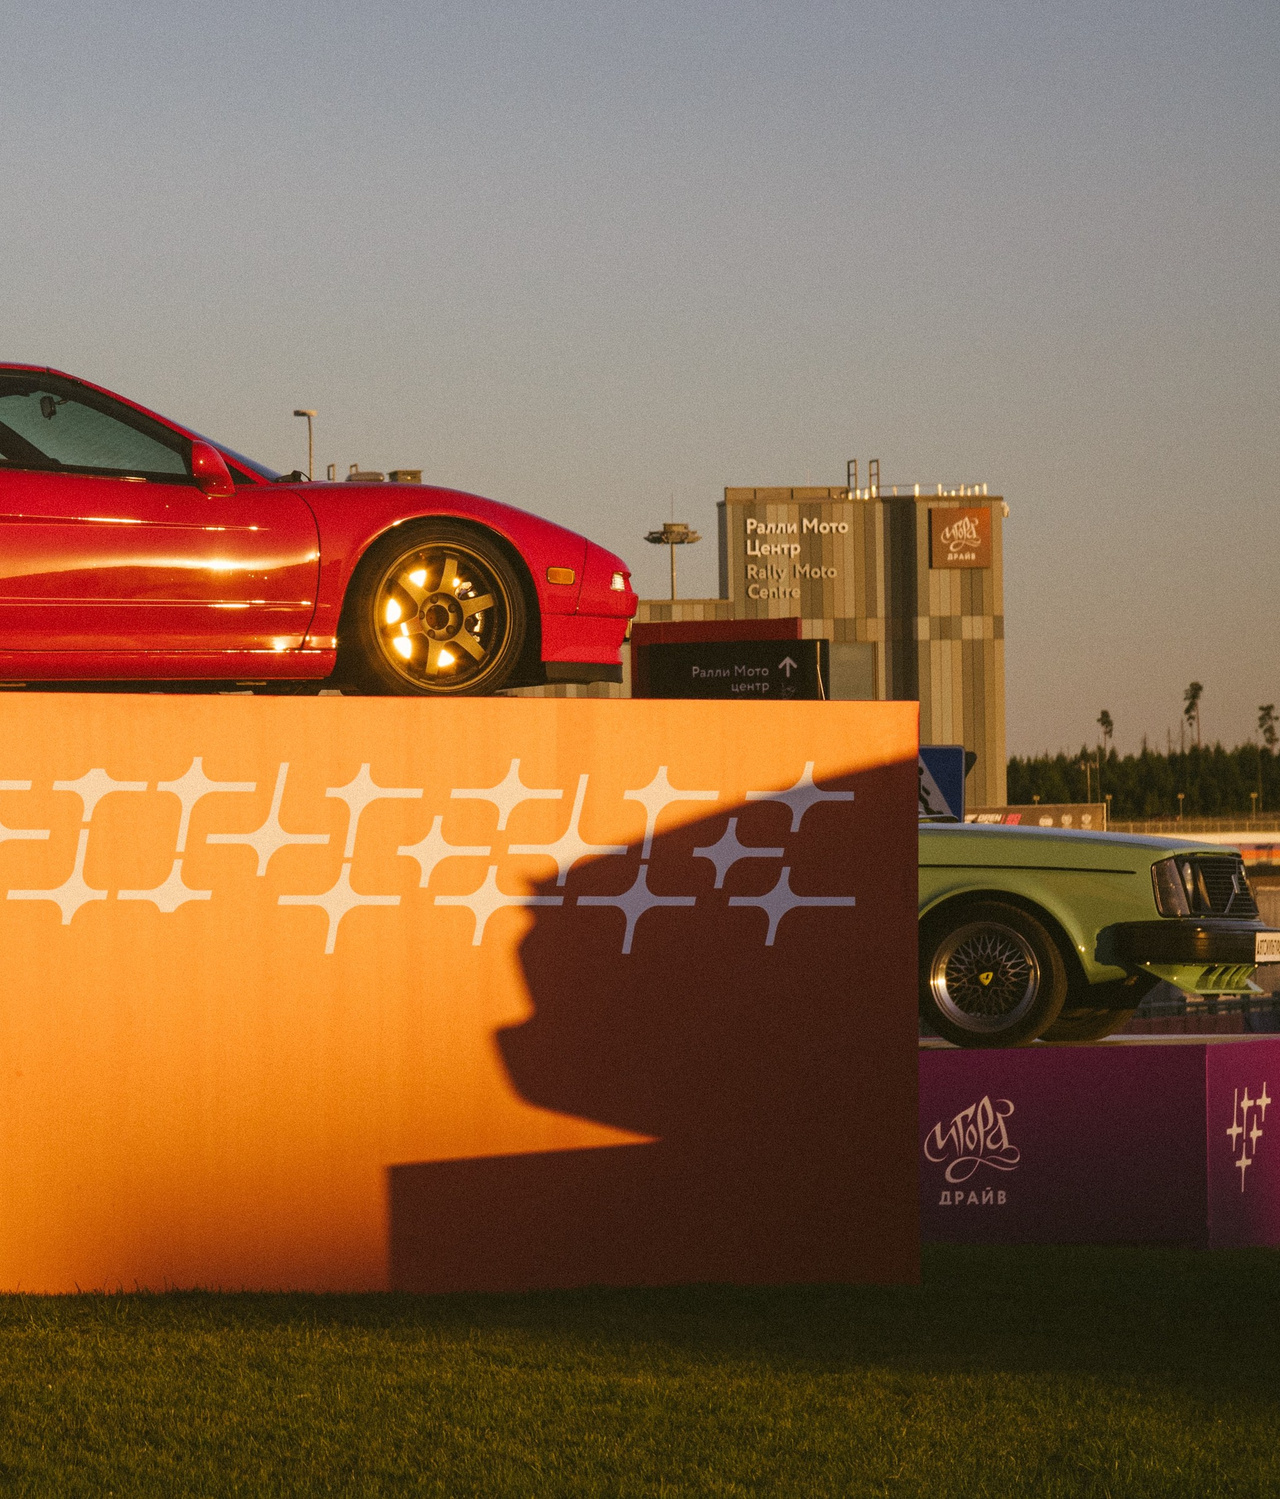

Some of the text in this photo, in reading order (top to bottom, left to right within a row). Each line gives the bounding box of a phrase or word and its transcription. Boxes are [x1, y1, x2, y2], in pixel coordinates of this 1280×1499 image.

[746, 517, 849, 534] Ралли Мото
[746, 539, 801, 558] Центр
[746, 563, 838, 582] Rally Moto
[747, 584, 801, 599] Centre
[692, 665, 770, 678] Ралли Мото
[731, 682, 770, 693] центр
[938, 1187, 1007, 1205] ДРАЙВ
